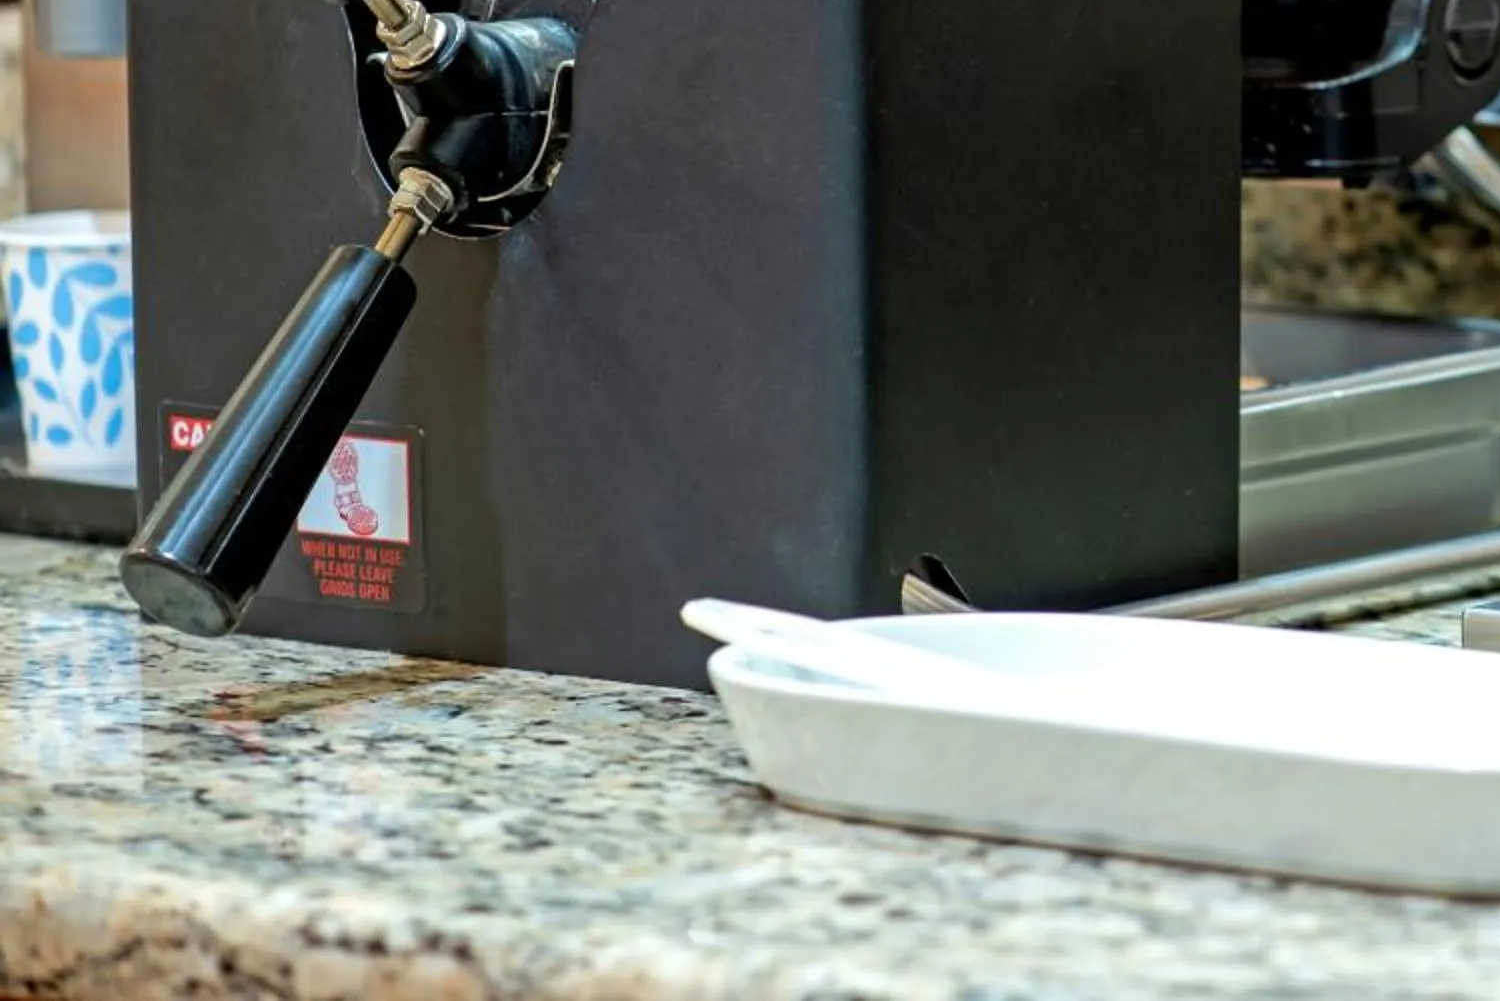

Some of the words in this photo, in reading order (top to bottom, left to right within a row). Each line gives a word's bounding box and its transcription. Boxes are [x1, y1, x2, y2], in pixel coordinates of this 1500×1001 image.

[314, 559, 355, 579] PLEASE
[360, 565, 393, 583] LEAVE
[359, 583, 389, 600] OPEN
